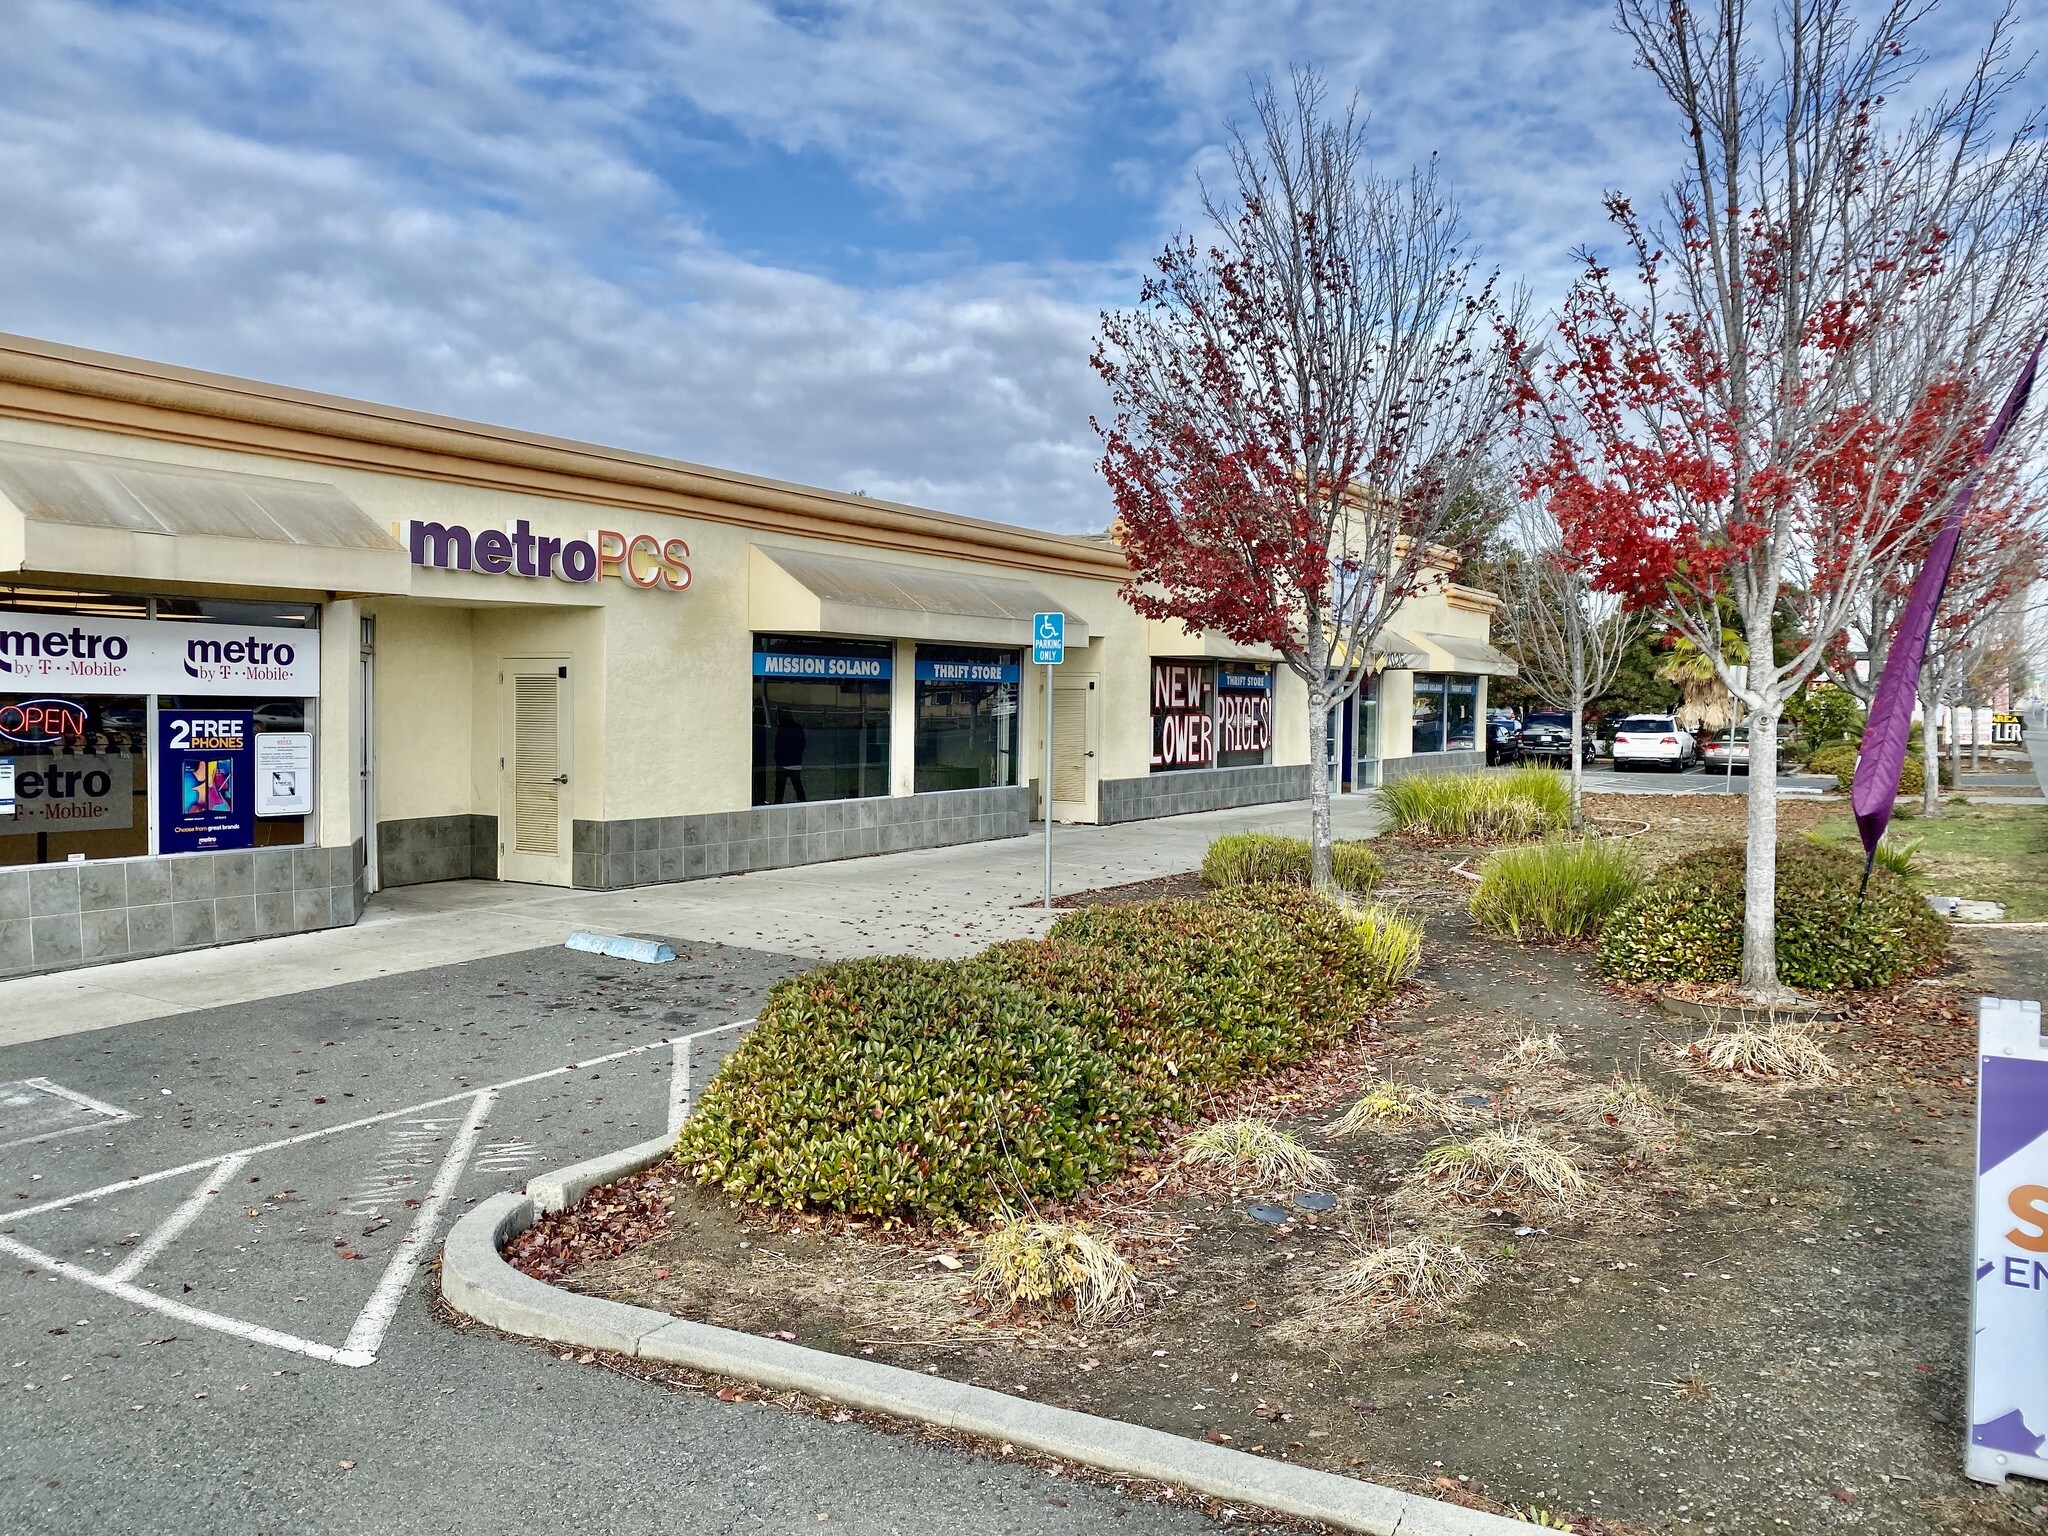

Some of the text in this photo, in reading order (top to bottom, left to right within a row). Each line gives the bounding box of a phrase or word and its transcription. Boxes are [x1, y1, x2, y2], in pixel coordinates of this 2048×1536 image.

[409, 518, 693, 592] metroPCS
[0, 628, 128, 660] metro
[188, 637, 295, 666] metro
[1035, 639, 1062, 650] PARKING
[1040, 650, 1057, 661] ONLY
[14, 660, 34, 677] by
[200, 666, 215, 682] by
[765, 656, 880, 676] MISSION SOLANO
[933, 664, 1002, 680] THRIFT STORE
[1226, 675, 1265, 687] THRIFT STORE
[0, 706, 83, 735] OPEN
[1993, 715, 2019, 723] AREA
[170, 720, 244, 749] 2 FREE
[191, 737, 244, 749] PHONES
[1150, 714, 1212, 763] LOWER
[15, 764, 112, 799] etro
